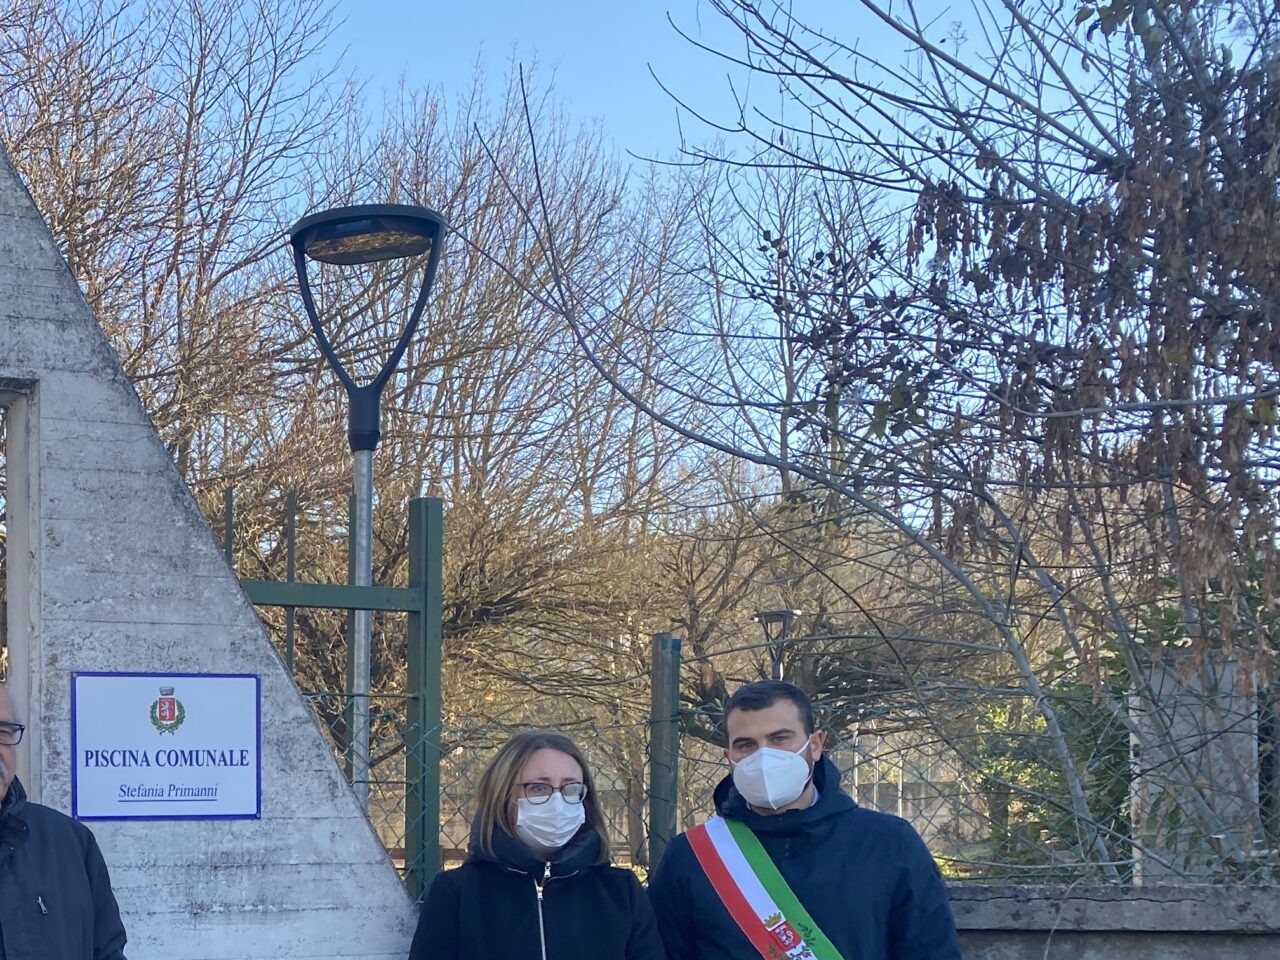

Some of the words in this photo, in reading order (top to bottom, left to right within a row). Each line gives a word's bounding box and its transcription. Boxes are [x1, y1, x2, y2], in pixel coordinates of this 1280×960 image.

[84, 749, 151, 768] PISCINA
[155, 749, 250, 767] COMUNALE
[118, 783, 164, 798] Stefania
[167, 783, 219, 797] Primanni
